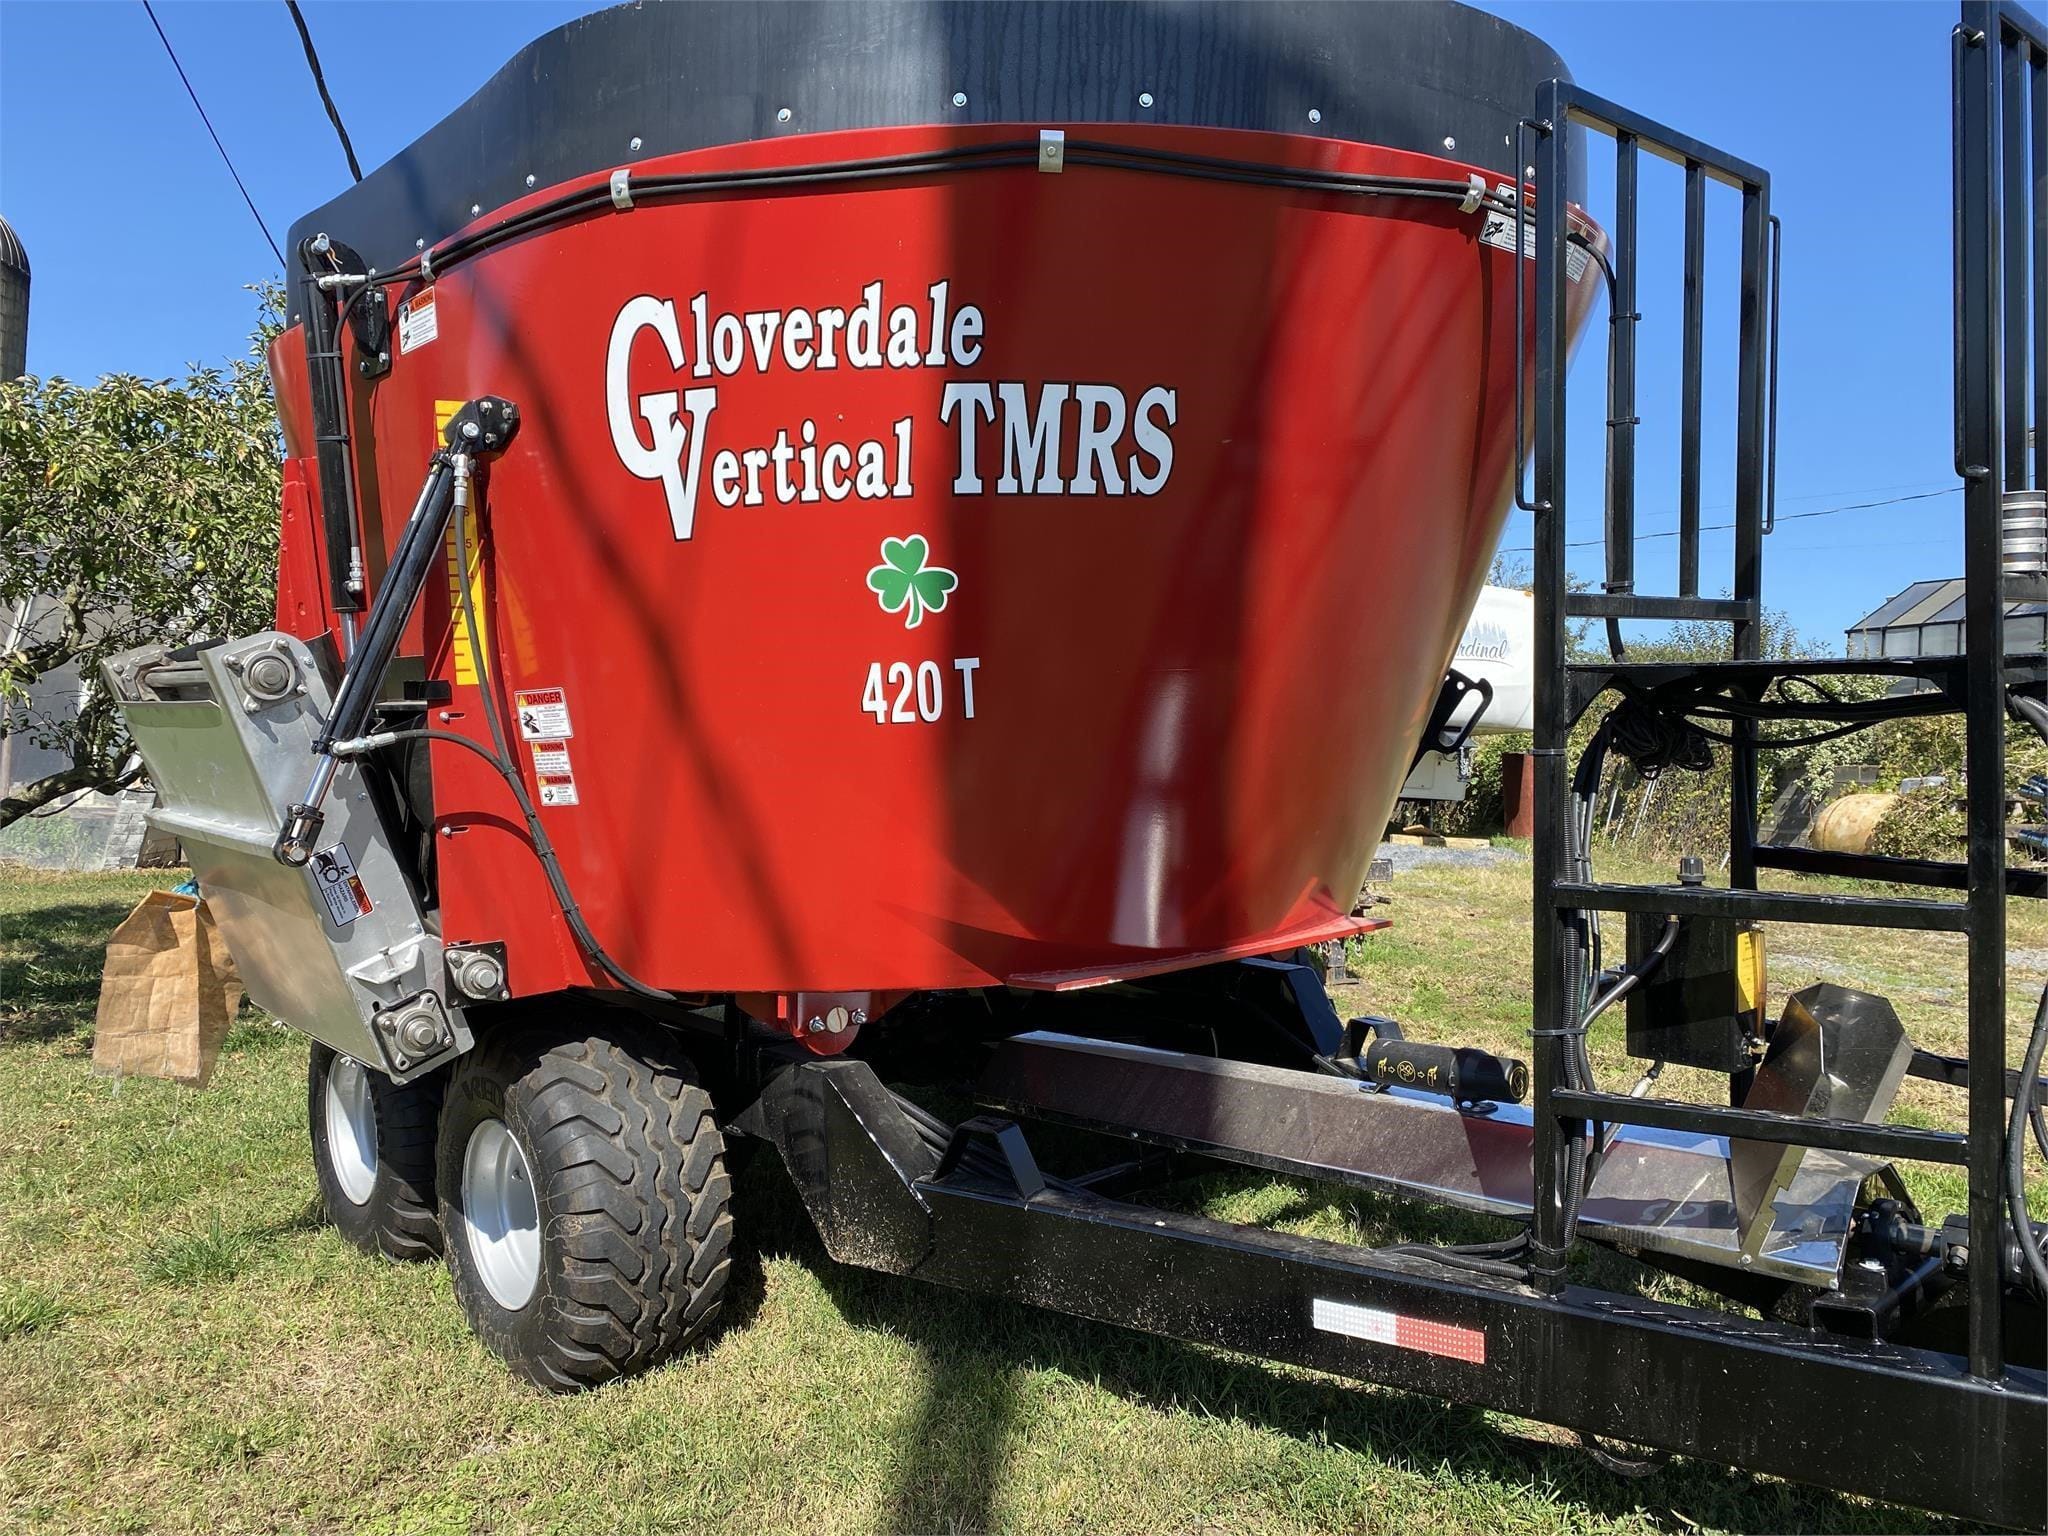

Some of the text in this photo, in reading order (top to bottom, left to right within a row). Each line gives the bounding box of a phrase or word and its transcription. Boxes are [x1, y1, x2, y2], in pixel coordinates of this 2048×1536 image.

[605, 279, 984, 480] Cloverdale
[637, 380, 1178, 541] Vertical TMRS
[465, 538, 472, 549] 5
[526, 692, 563, 705] DANGER
[861, 656, 981, 724] 420 T
[342, 880, 360, 914] ENTANGLEMEN
